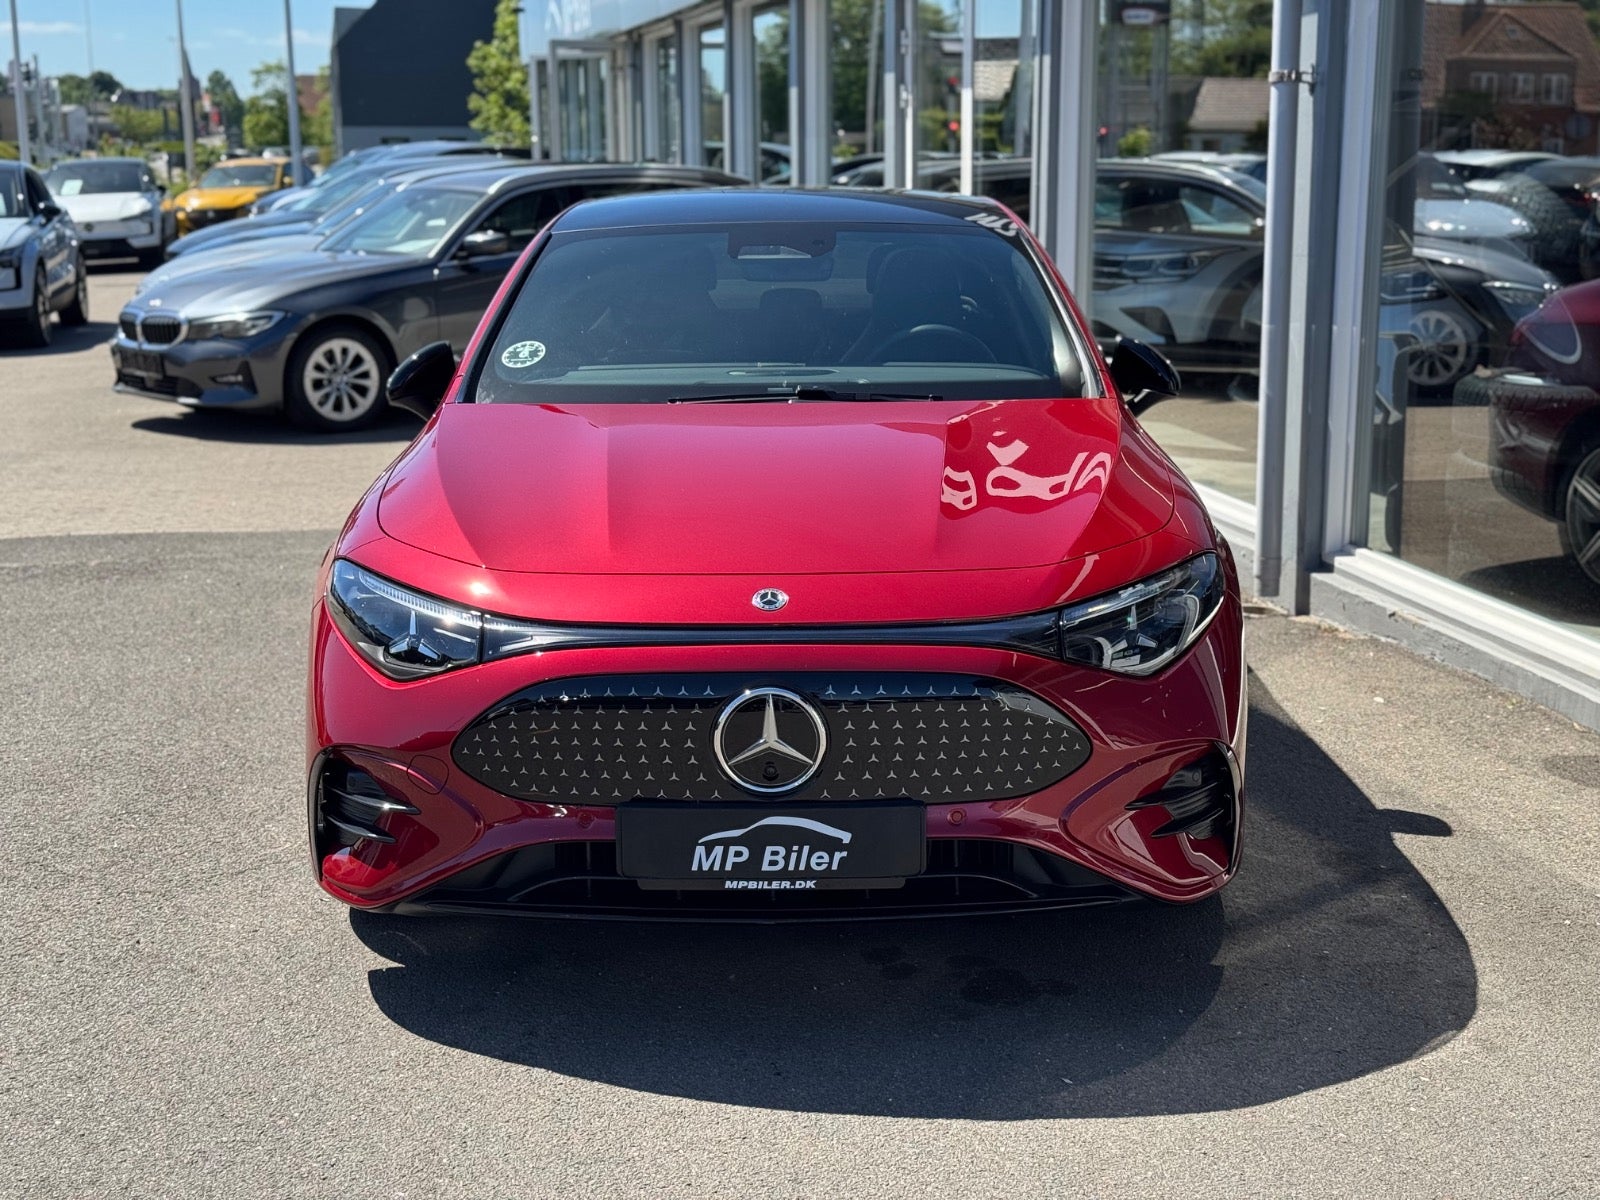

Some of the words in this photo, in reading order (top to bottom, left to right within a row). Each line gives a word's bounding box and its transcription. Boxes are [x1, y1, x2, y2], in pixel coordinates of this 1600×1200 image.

[691, 845, 750, 872] MP
[761, 845, 848, 872] Biler
[724, 880, 817, 889] MPBILER.DK
